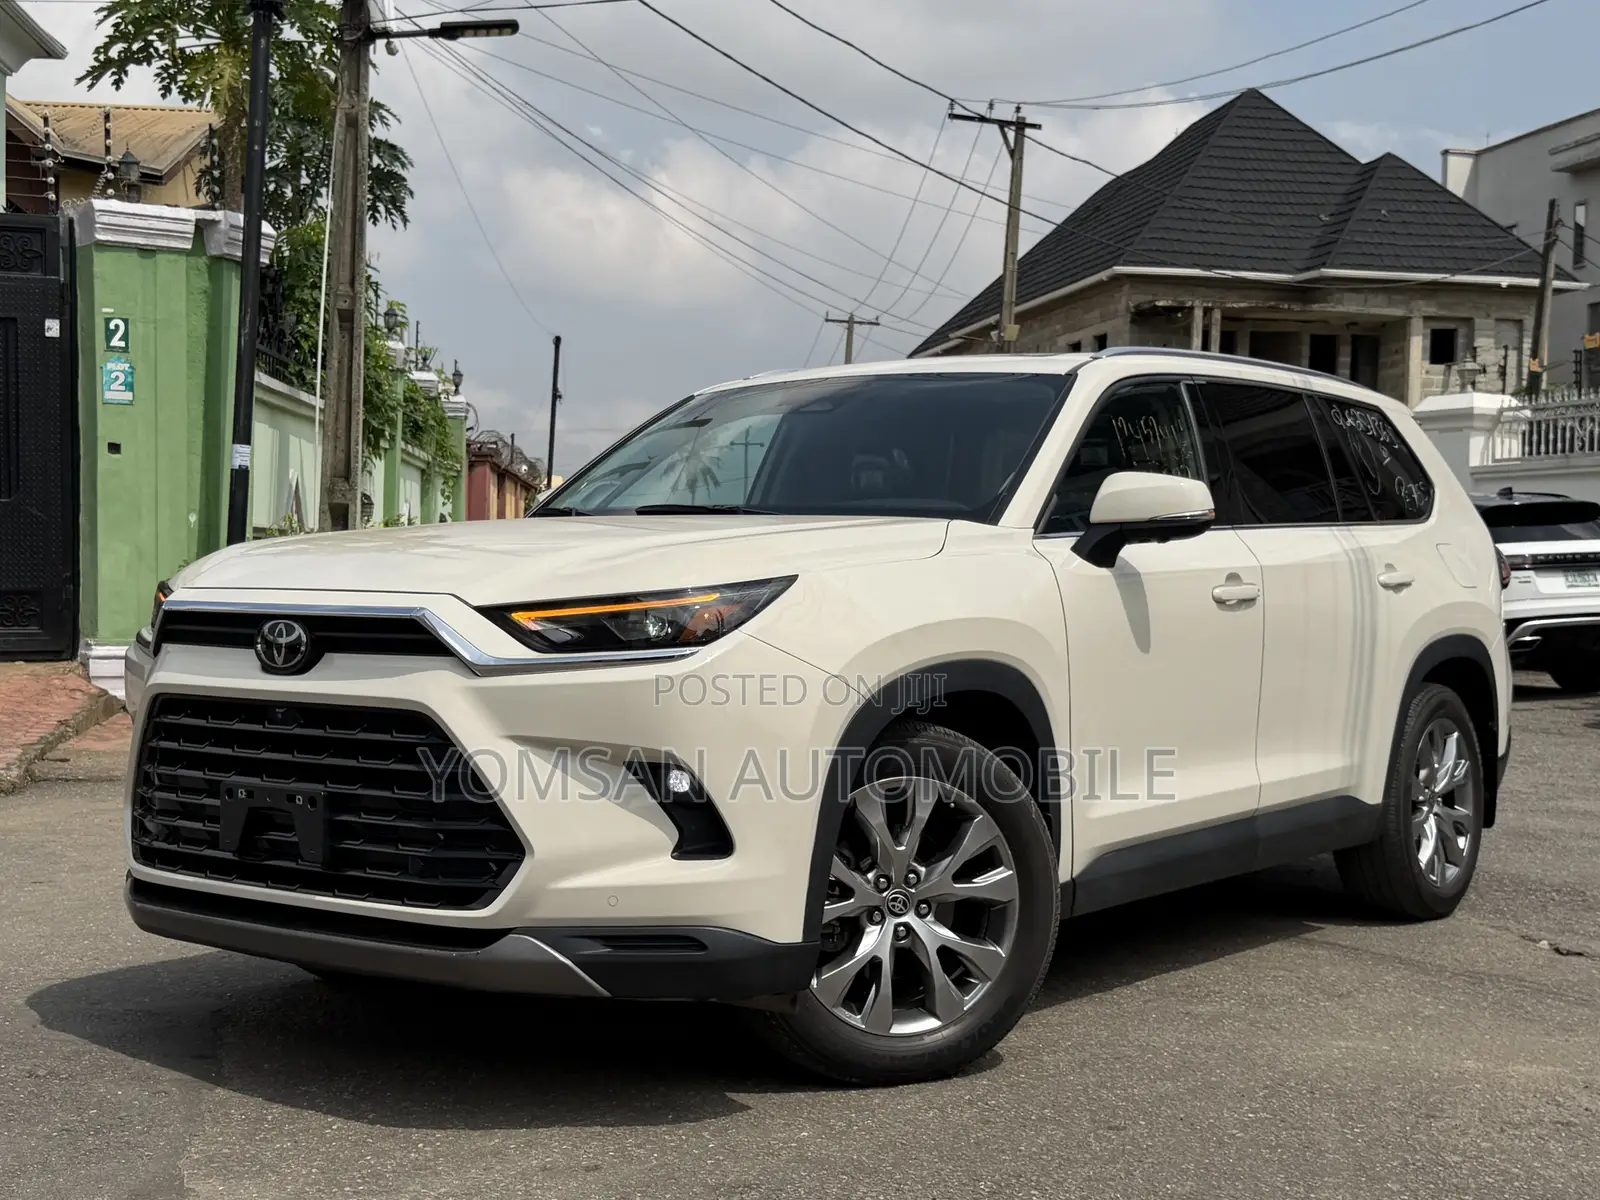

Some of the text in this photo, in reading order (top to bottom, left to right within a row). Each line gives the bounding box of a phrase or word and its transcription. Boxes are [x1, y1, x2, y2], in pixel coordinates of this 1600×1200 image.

[109, 318, 126, 348] 2
[106, 361, 130, 371] PLOT
[110, 371, 126, 391] 2
